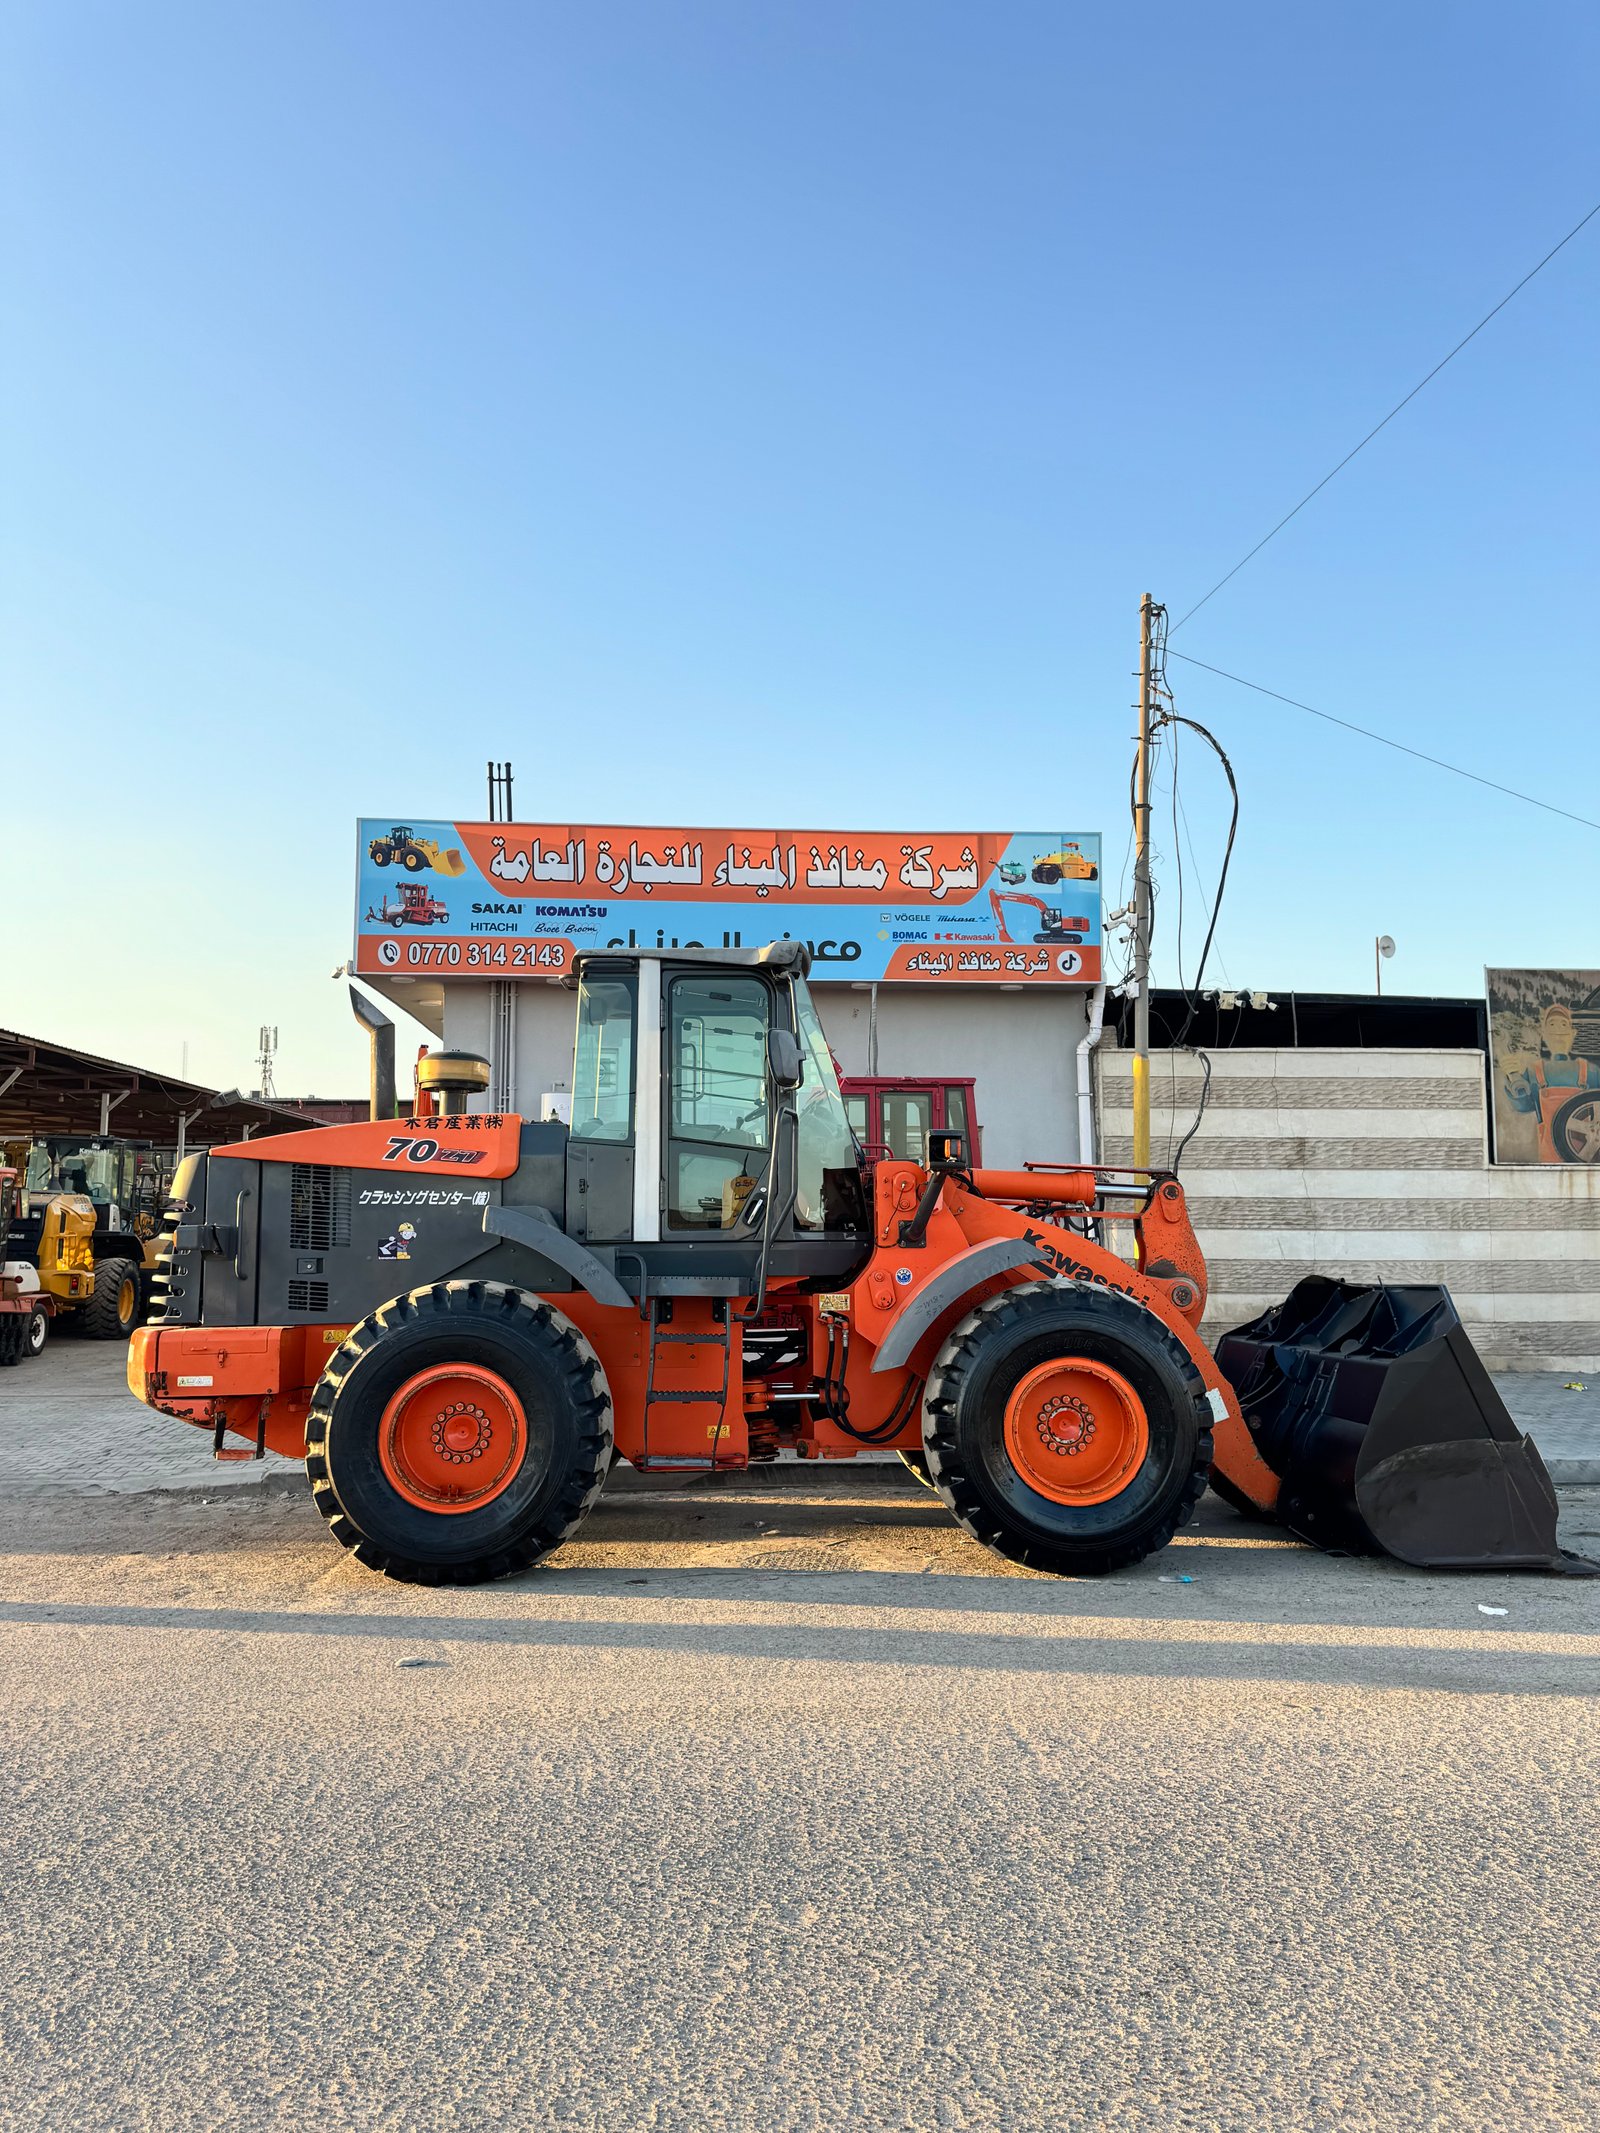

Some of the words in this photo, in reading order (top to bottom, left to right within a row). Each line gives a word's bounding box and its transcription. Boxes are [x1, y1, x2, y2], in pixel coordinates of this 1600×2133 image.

[490, 836, 585, 884] العامة
[595, 840, 703, 894] للتجارة
[712, 843, 797, 898] الميناء
[806, 846, 889, 891] منافذ
[899, 846, 979, 899] شركة
[471, 903, 523, 914] SAKAI
[536, 904, 607, 918] KOMATSU
[895, 913, 931, 922] VÖGELE
[470, 922, 518, 932] HITACHI
[892, 931, 928, 939] BOMAG
[954, 933, 995, 941] Kawasaki
[407, 942, 461, 965] 0770
[467, 943, 507, 966] 314
[512, 944, 565, 966] 2143
[906, 951, 953, 976] الميناء
[957, 951, 1001, 971] منافذ
[1004, 949, 1049, 976] شركة
